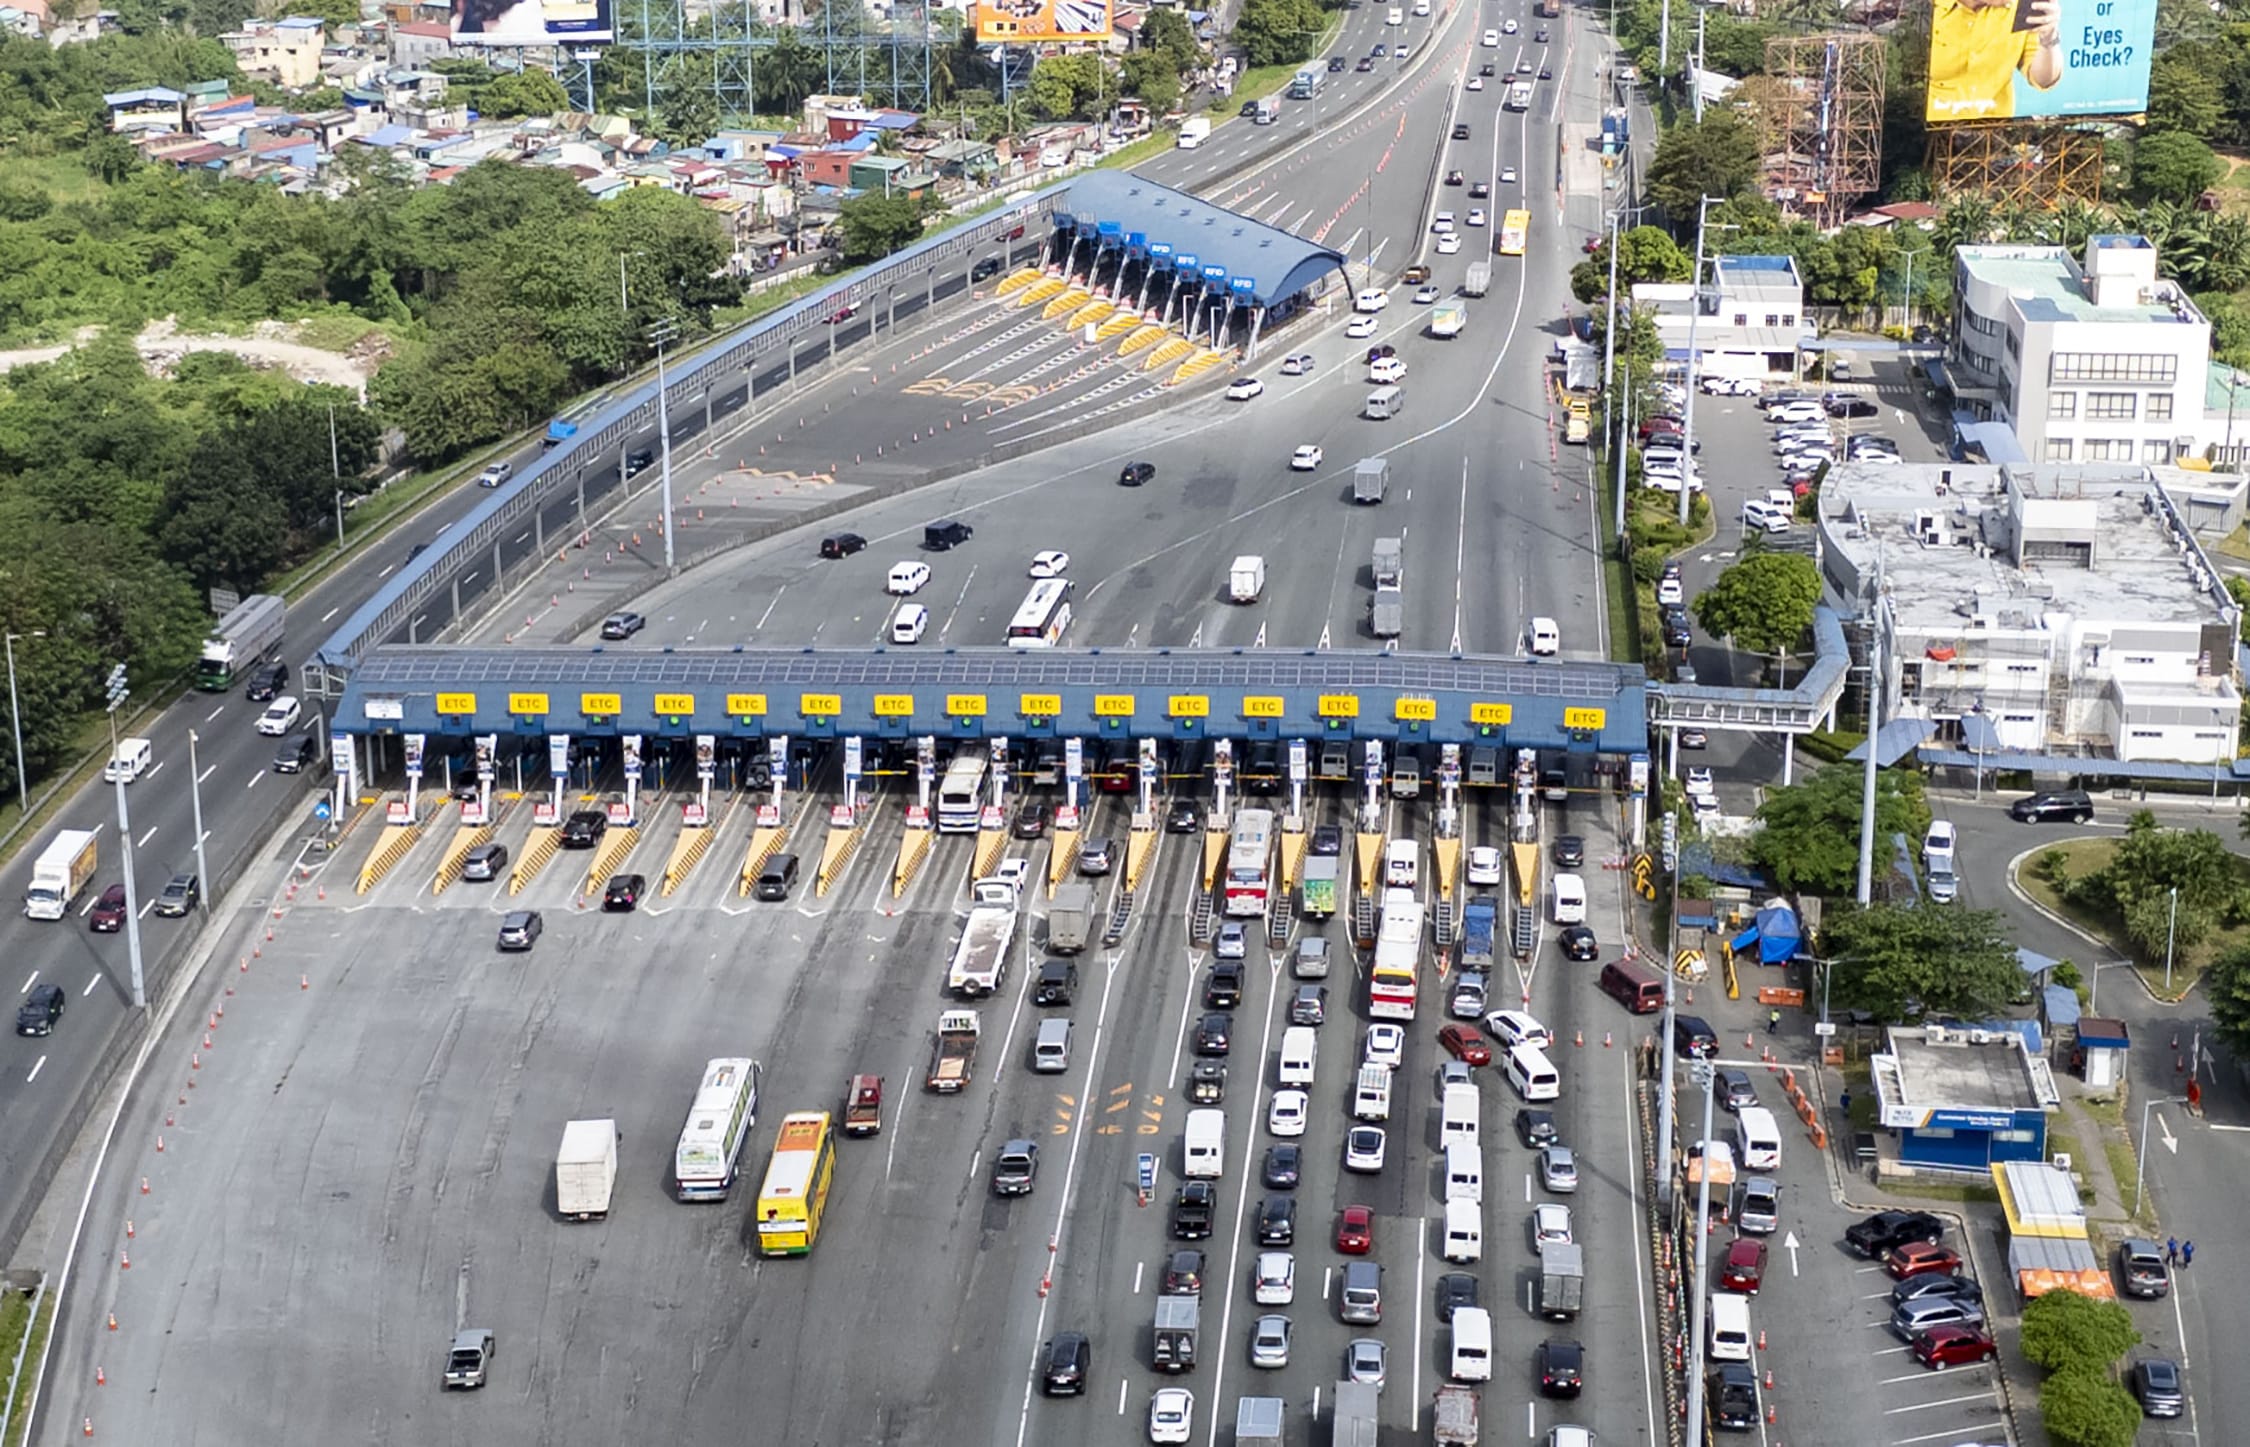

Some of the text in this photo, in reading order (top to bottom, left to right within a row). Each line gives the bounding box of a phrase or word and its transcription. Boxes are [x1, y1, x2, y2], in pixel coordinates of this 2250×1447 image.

[2097, 2, 2113, 16] or
[2083, 26, 2123, 49] Eyes
[2070, 46, 2133, 68] Check?
[445, 698, 468, 708] ETC
[518, 699, 541, 709] ETC
[591, 699, 614, 709] ETC
[663, 700, 686, 710] ETC
[736, 700, 759, 710] ETC
[810, 700, 833, 710] ETC
[883, 701, 906, 711] ETC
[956, 701, 979, 711] ETC
[1030, 700, 1053, 710] ETC
[1104, 701, 1127, 711] ETC
[1178, 702, 1201, 712] ETC
[1252, 703, 1275, 713] ETC
[1328, 701, 1351, 711] ETC
[1404, 706, 1427, 716] ETC
[1480, 709, 1503, 719] ETC
[1573, 714, 1596, 725] ETC
